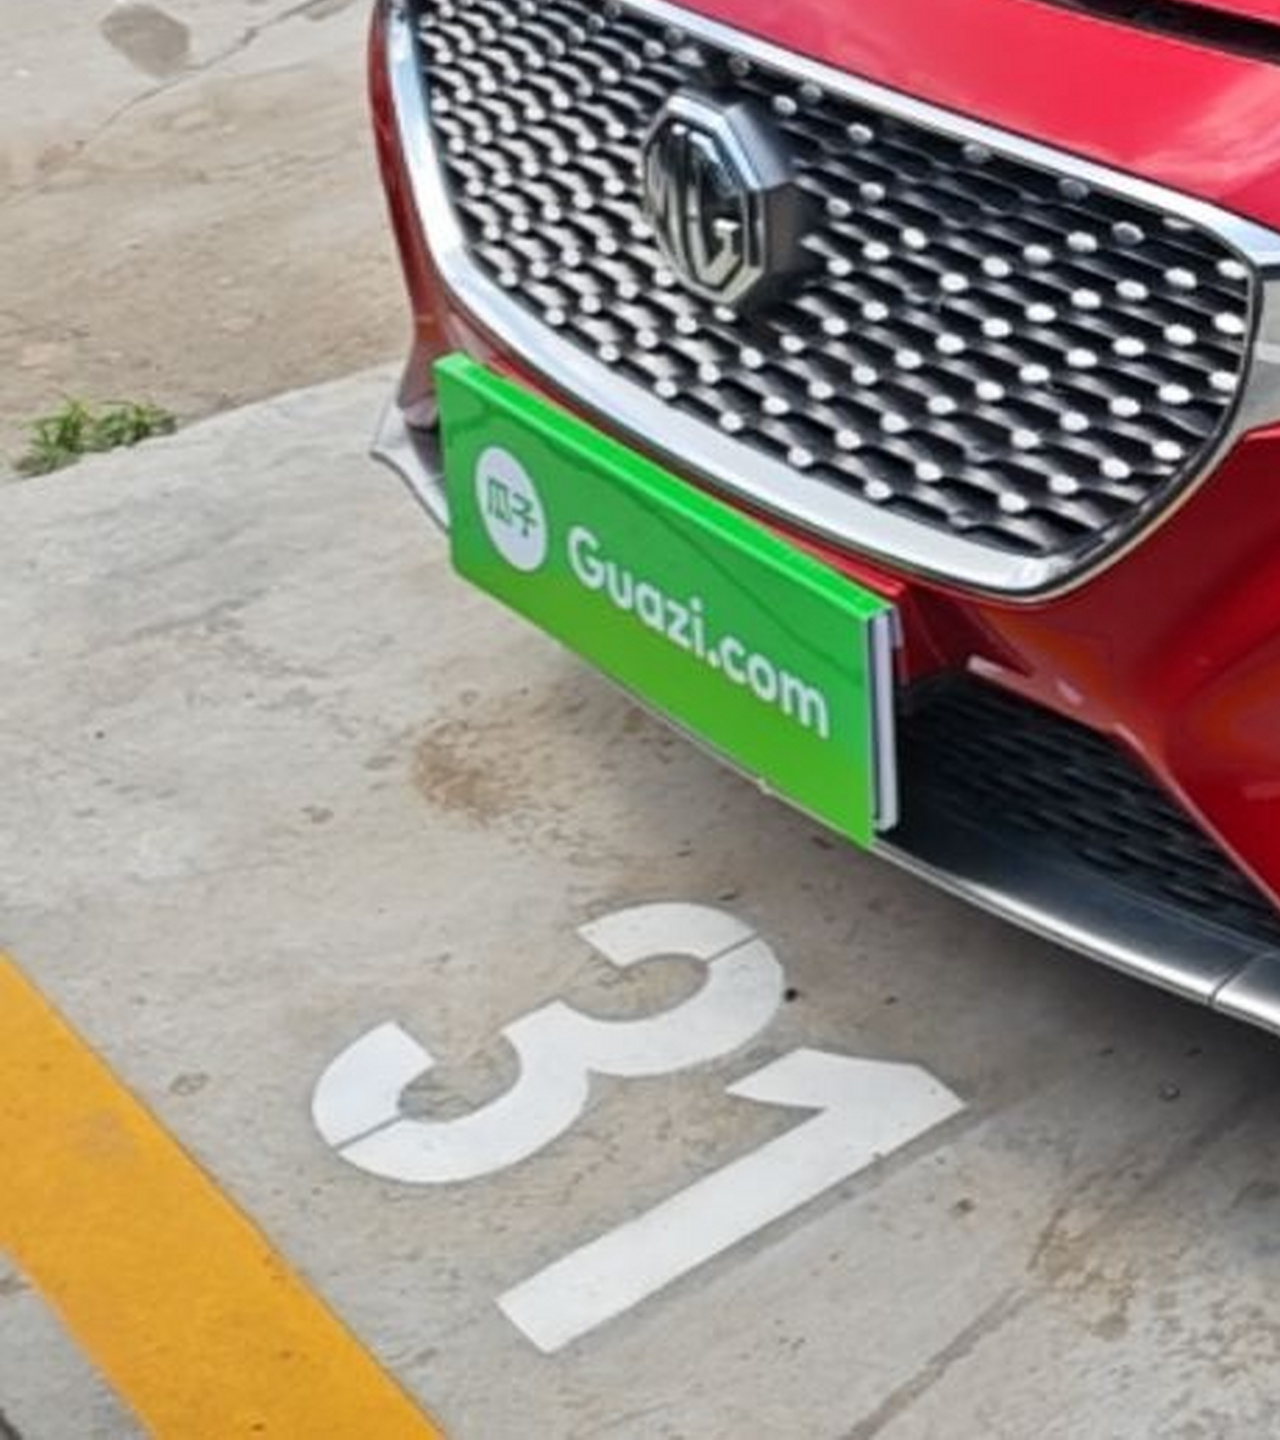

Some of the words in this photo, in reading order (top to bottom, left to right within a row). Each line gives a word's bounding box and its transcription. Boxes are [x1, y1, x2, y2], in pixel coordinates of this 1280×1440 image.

[647, 116, 752, 294] MG
[486, 477, 539, 539] 瓜子
[567, 525, 831, 740] Guazi.com
[311, 901, 968, 1354] 31
